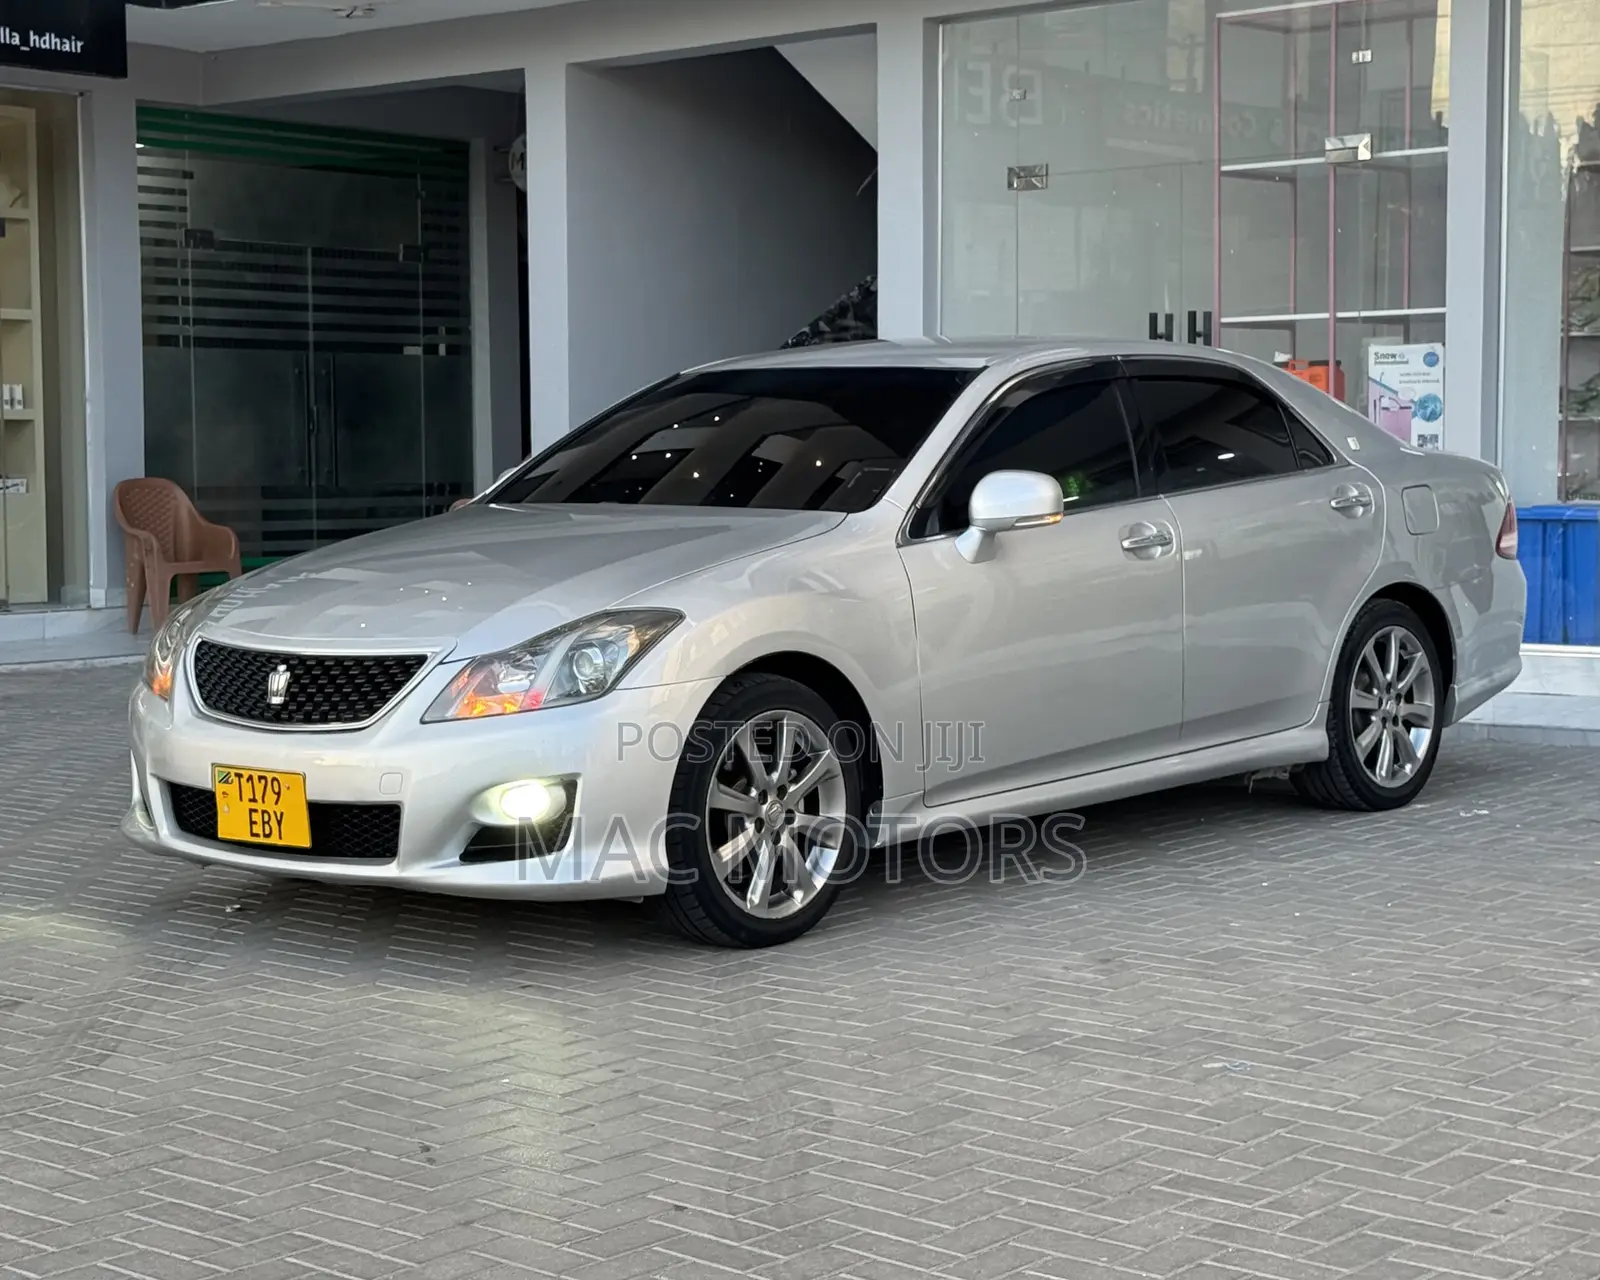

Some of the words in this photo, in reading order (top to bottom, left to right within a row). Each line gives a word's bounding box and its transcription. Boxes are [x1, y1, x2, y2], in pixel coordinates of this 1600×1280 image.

[0, 26, 84, 53] lla_hdhair
[234, 772, 282, 805] T179
[248, 808, 284, 840] EBY
